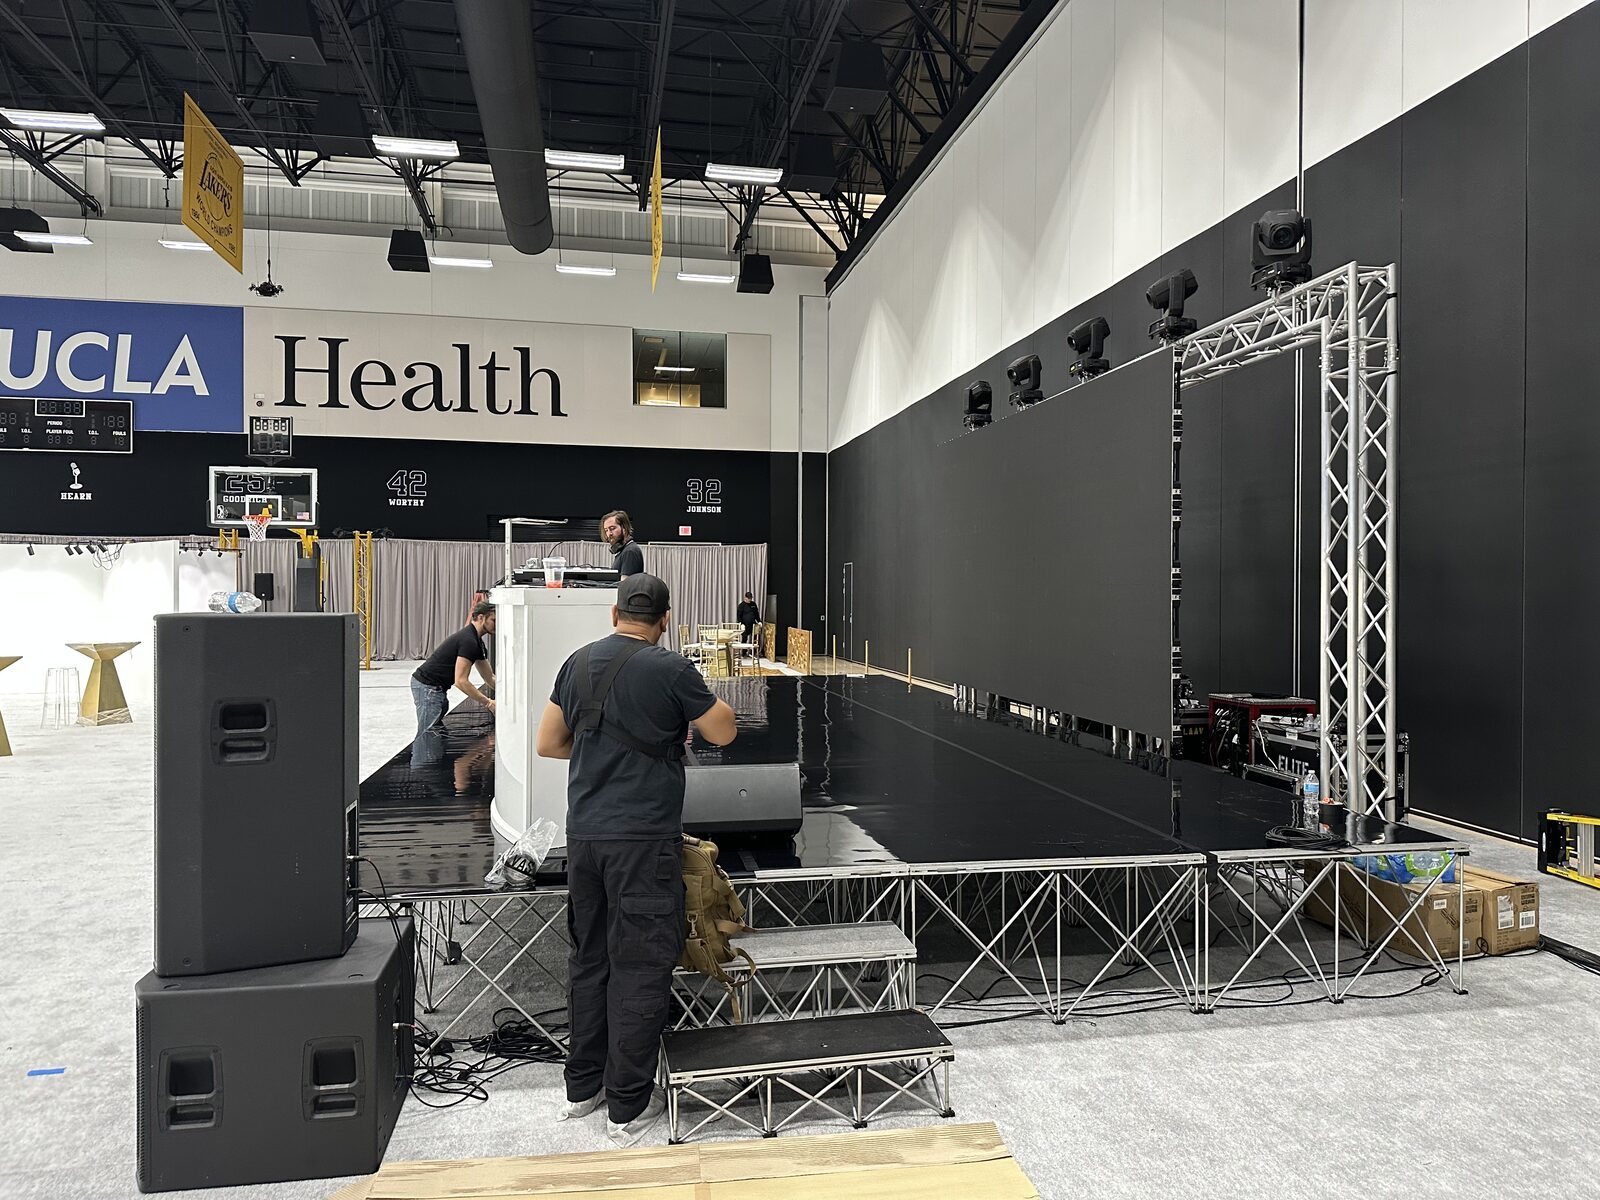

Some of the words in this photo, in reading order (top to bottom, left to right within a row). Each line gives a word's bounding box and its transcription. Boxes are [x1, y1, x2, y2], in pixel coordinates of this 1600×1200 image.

[0, 328, 210, 396] UCLA
[274, 335, 568, 417] Health
[225, 474, 266, 494] 25
[386, 469, 427, 497] 42
[686, 478, 722, 504] 32
[60, 492, 92, 500] HEARN
[388, 498, 425, 507] WORTHY
[686, 505, 722, 513] JOHNSON
